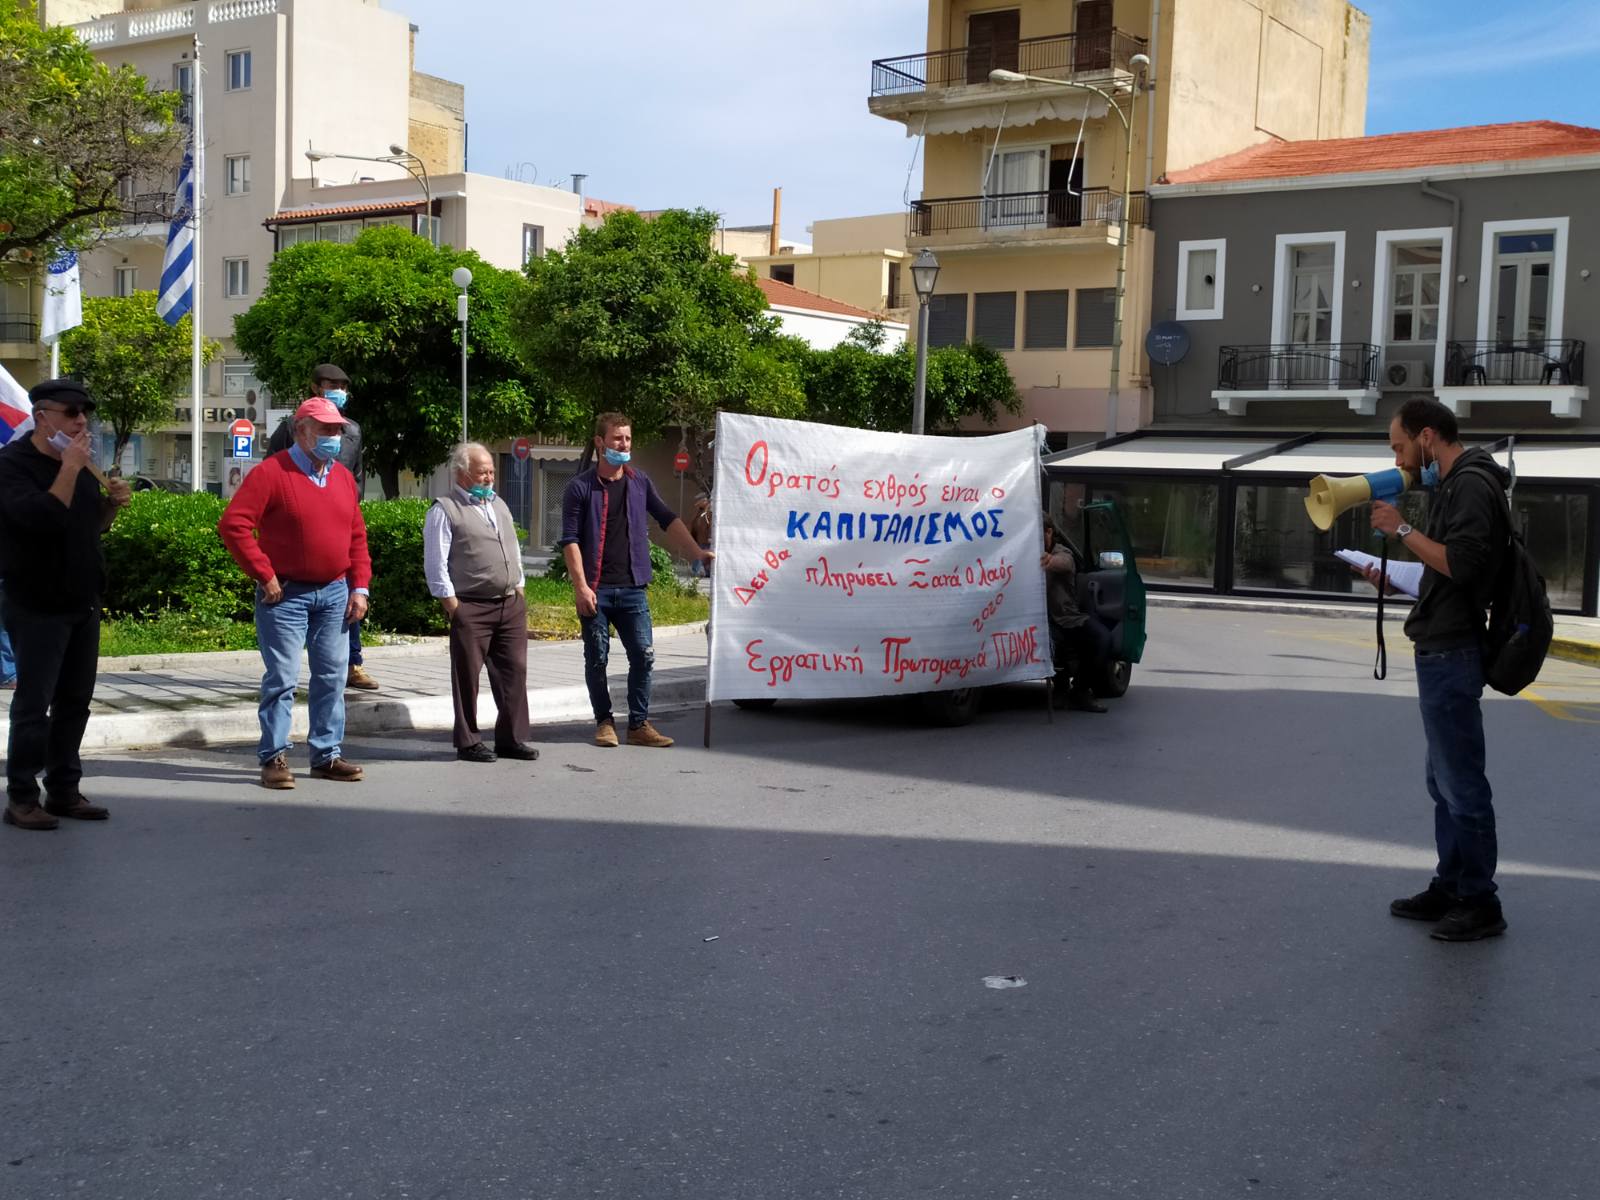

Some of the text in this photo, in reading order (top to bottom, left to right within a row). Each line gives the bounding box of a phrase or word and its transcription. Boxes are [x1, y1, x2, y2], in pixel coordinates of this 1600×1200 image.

[237, 437, 249, 450] P
[745, 440, 840, 499] Ορατός
[863, 473, 928, 507] εχθρός
[941, 476, 979, 503] είναι
[787, 509, 1004, 545] ΚΑΠΙΤΑΛΙΣΜΟΣ
[734, 570, 769, 606] Δεν
[764, 549, 792, 570] θα
[978, 557, 1013, 588] λαός
[972, 593, 1004, 633] 2020
[745, 639, 864, 687] Εργατική
[880, 636, 987, 684] Πρωτομαγιά
